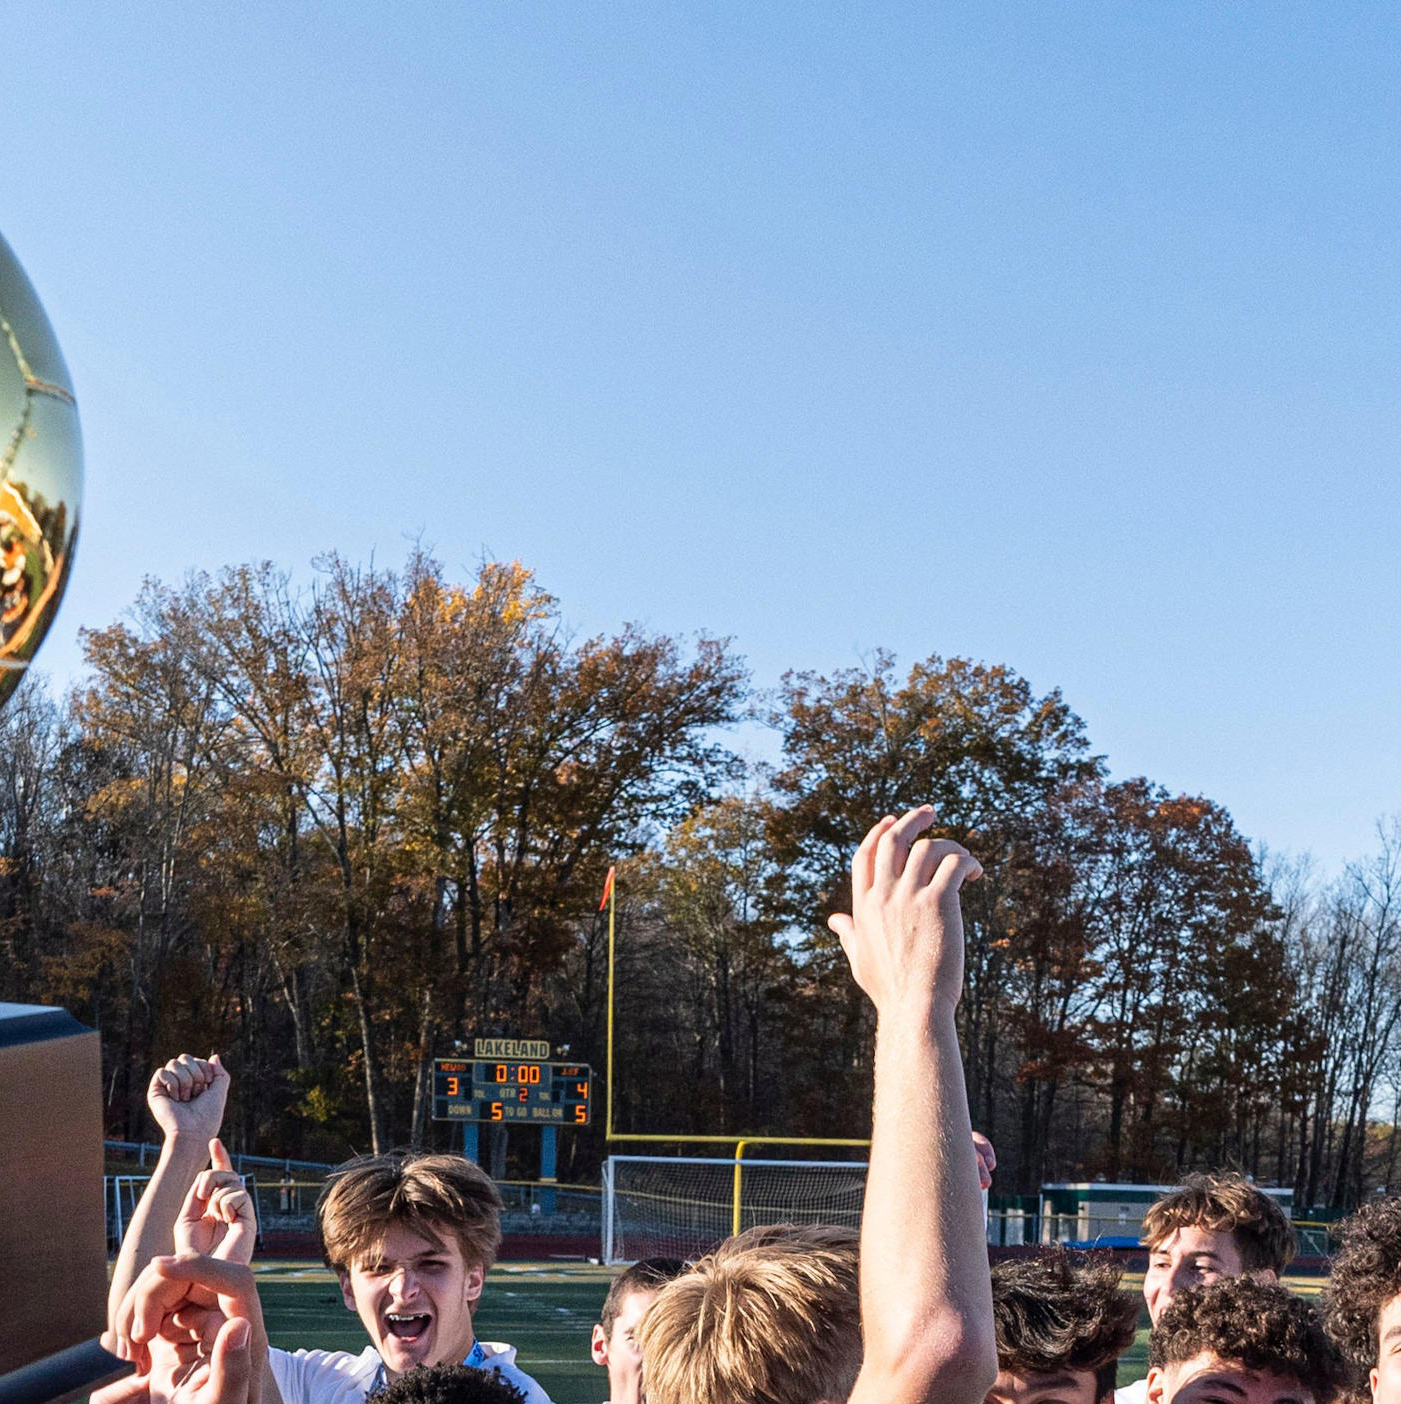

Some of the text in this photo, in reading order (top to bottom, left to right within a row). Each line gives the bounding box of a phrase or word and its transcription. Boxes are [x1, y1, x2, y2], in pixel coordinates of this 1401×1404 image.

[476, 1040, 548, 1057] LAKELAND
[496, 1065, 540, 1084] 0:00
[447, 1077, 459, 1095] 3
[576, 1082, 588, 1099] 4
[518, 1088, 528, 1102] 2
[448, 1105, 471, 1115] DOWN
[491, 1102, 502, 1120] 5
[504, 1107, 514, 1117] TO
[516, 1107, 527, 1117] GO
[532, 1108, 549, 1118] BALL
[575, 1105, 586, 1123] 5
